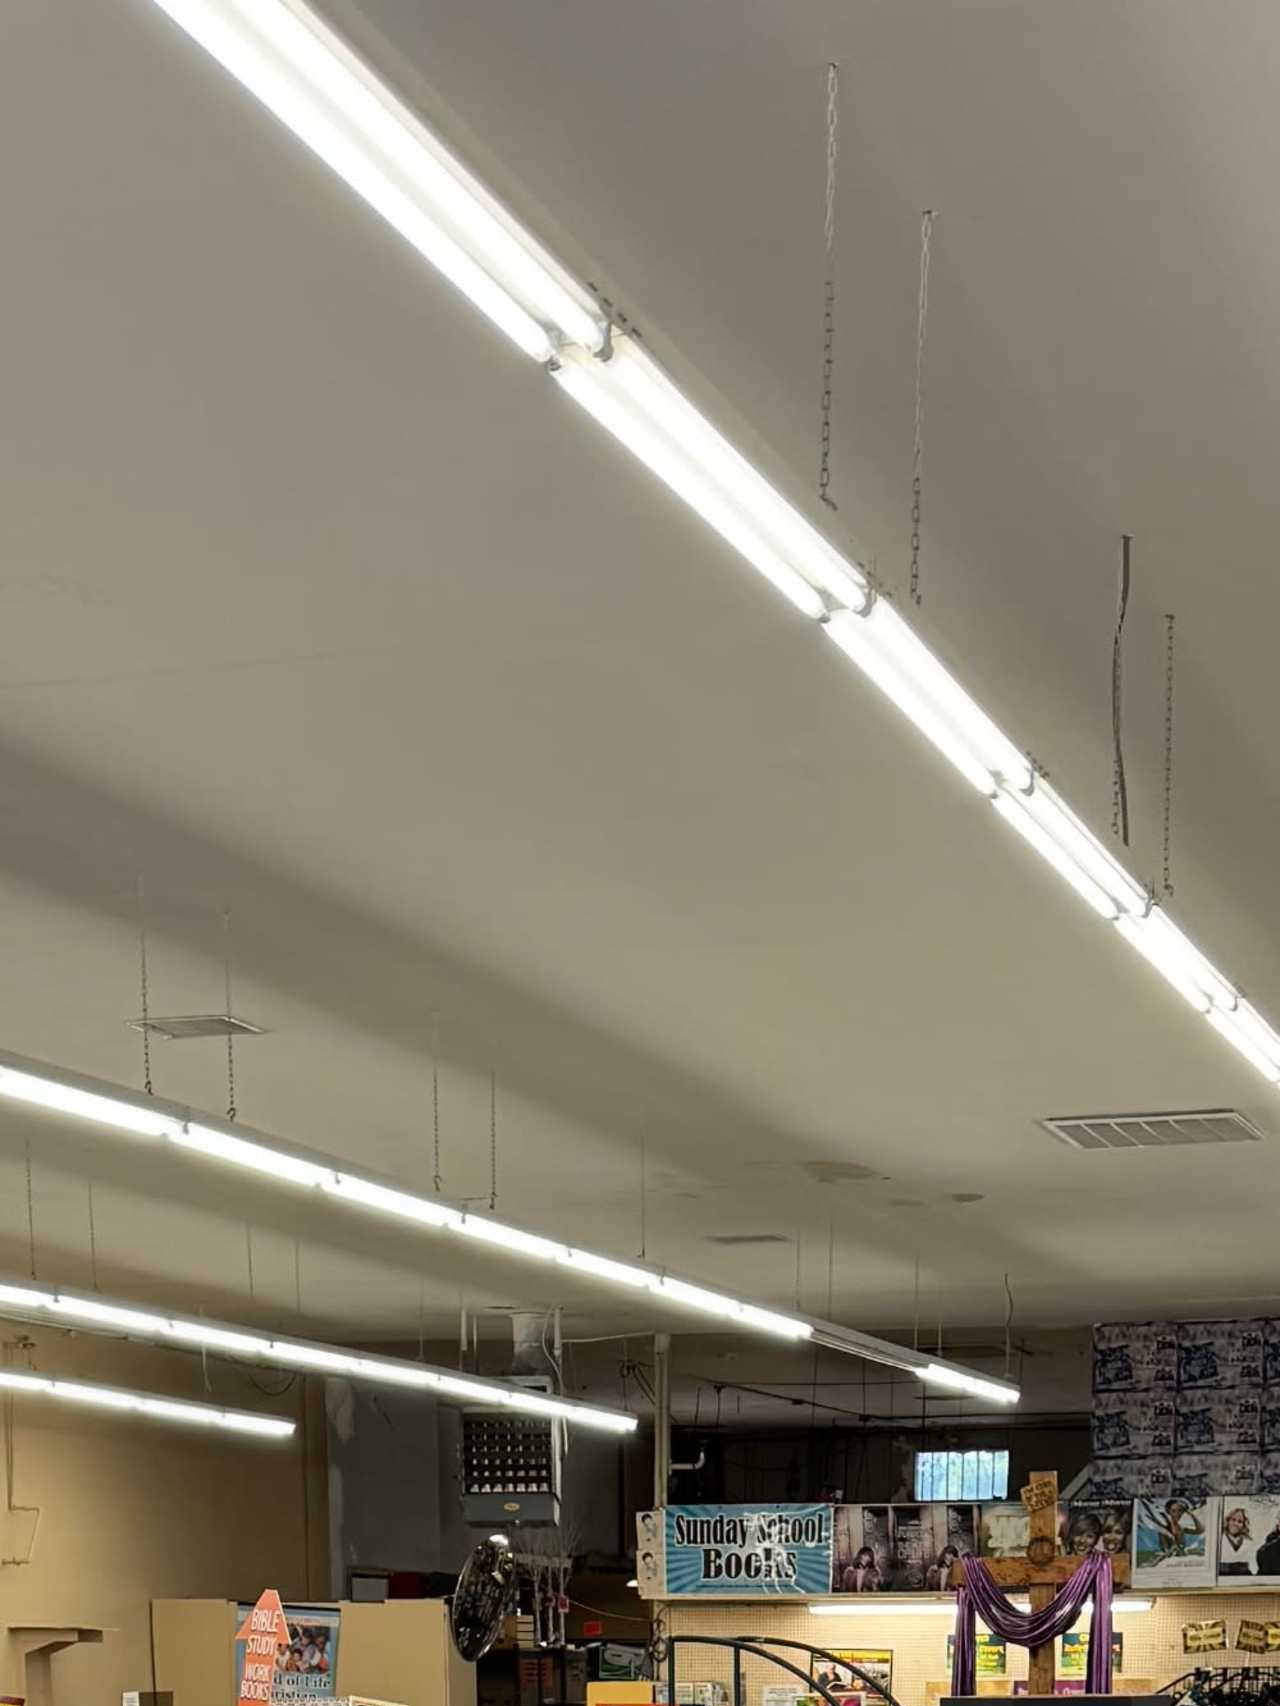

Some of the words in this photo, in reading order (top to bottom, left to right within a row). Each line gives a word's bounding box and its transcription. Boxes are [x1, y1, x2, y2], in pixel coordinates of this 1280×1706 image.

[676, 1514, 750, 1548] Sunday
[756, 1514, 825, 1545] School
[701, 1549, 798, 1581] Books
[251, 1609, 280, 1633] BIBLE
[247, 1634, 278, 1655] STUDY
[245, 1664, 271, 1682] WORK
[241, 1680, 269, 1702] BOOKS
